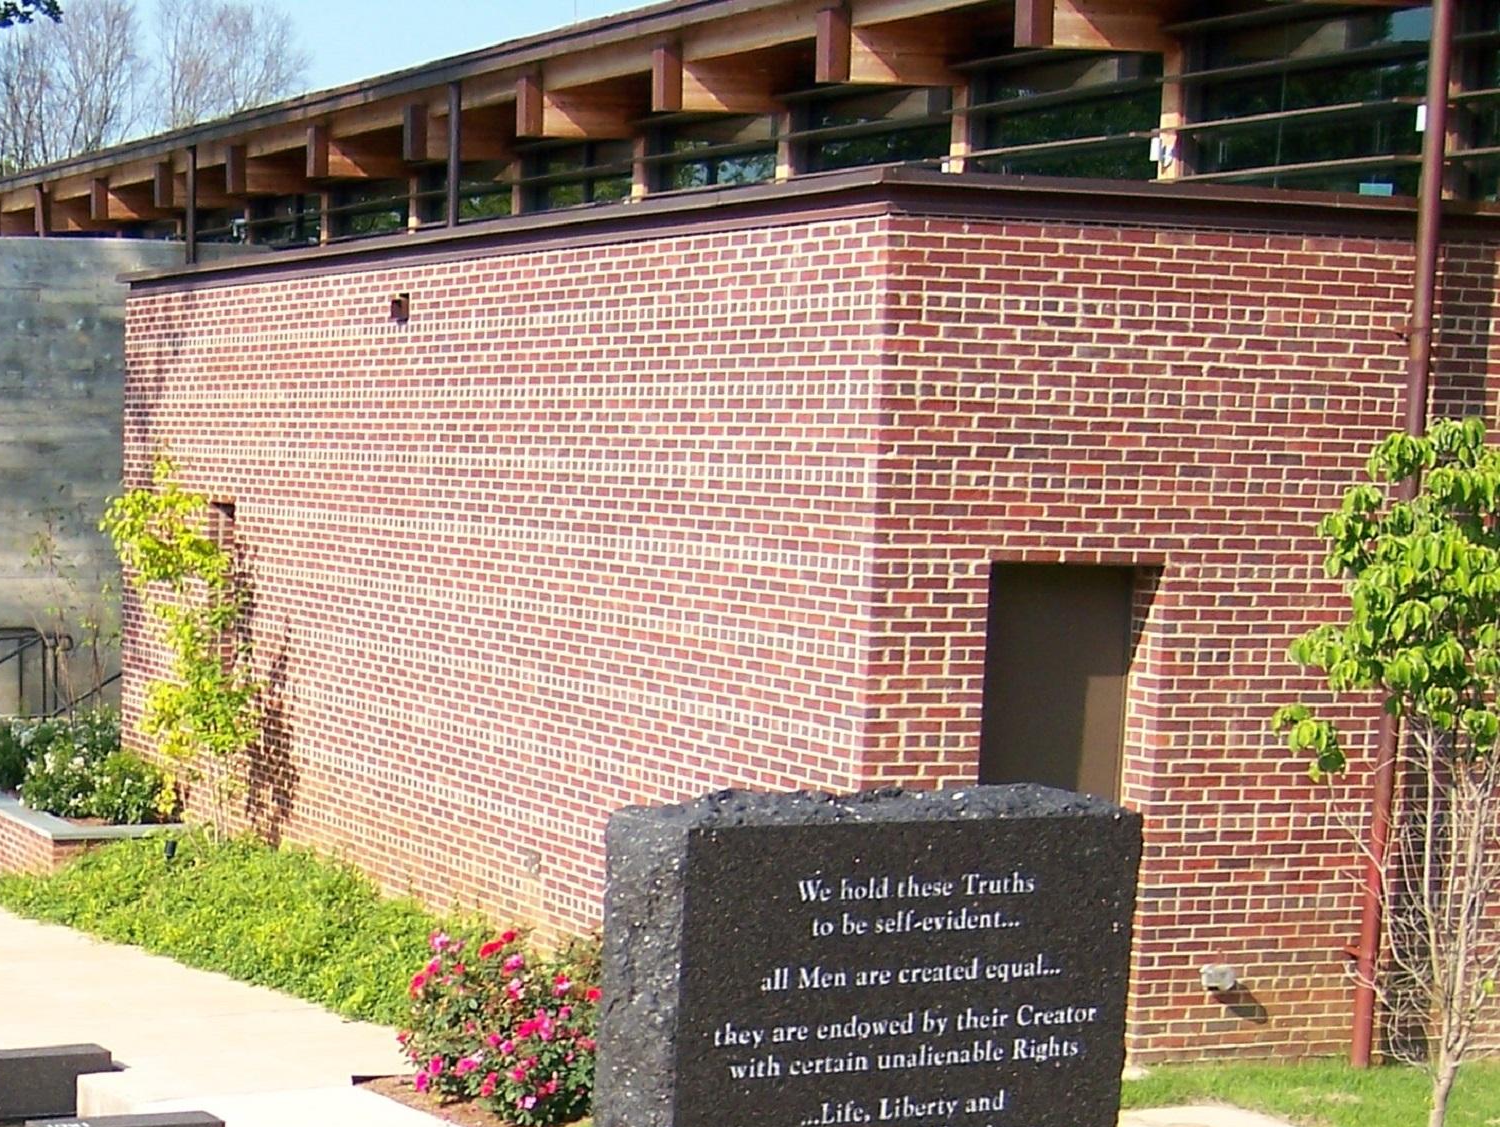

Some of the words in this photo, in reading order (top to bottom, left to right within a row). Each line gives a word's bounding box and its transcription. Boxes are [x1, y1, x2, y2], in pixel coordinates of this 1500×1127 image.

[799, 879, 831, 903] We
[840, 877, 888, 901] hold
[898, 876, 953, 898] these
[962, 874, 1035, 896] Truths
[812, 916, 834, 937] to
[843, 913, 867, 935] be
[761, 968, 789, 992] all
[798, 967, 846, 990] Men
[856, 968, 891, 986] are
[898, 958, 977, 984] created
[714, 1024, 764, 1049] they
[772, 1024, 809, 1043] are
[817, 1014, 914, 1040] endowed
[922, 1012, 948, 1036] by
[957, 1009, 1008, 1031] their
[1017, 1004, 1097, 1026] Creator
[729, 1055, 780, 1080] with
[789, 1051, 868, 1076] certain
[877, 1041, 1004, 1070] unalienable
[1012, 1038, 1079, 1063] Rights
[879, 1095, 958, 1121] Liberty
[965, 1091, 1005, 1113] and
